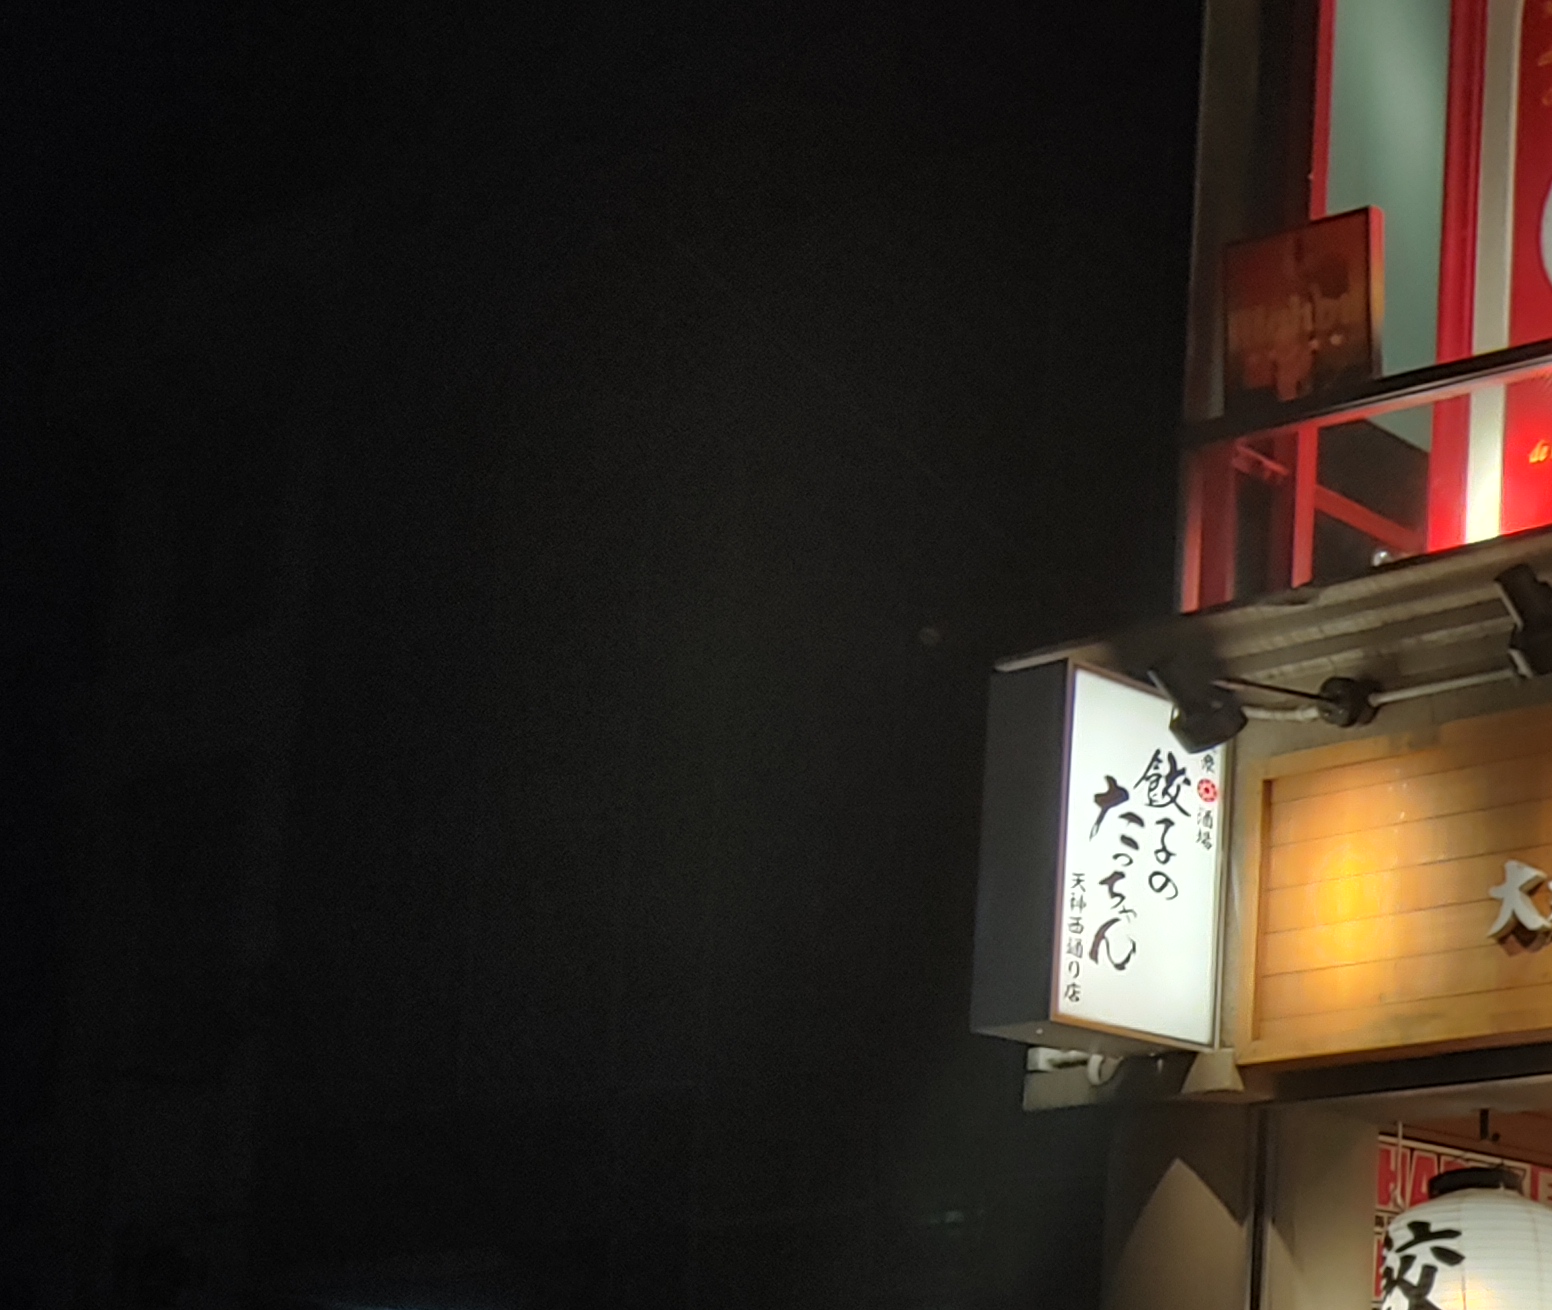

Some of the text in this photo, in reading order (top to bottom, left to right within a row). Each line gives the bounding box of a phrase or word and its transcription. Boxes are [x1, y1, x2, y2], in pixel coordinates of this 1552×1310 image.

[1088, 775, 1146, 971] たっちゃん
[1133, 748, 1192, 901] 餃子の
[1063, 872, 1087, 1003] 天神西通り店
